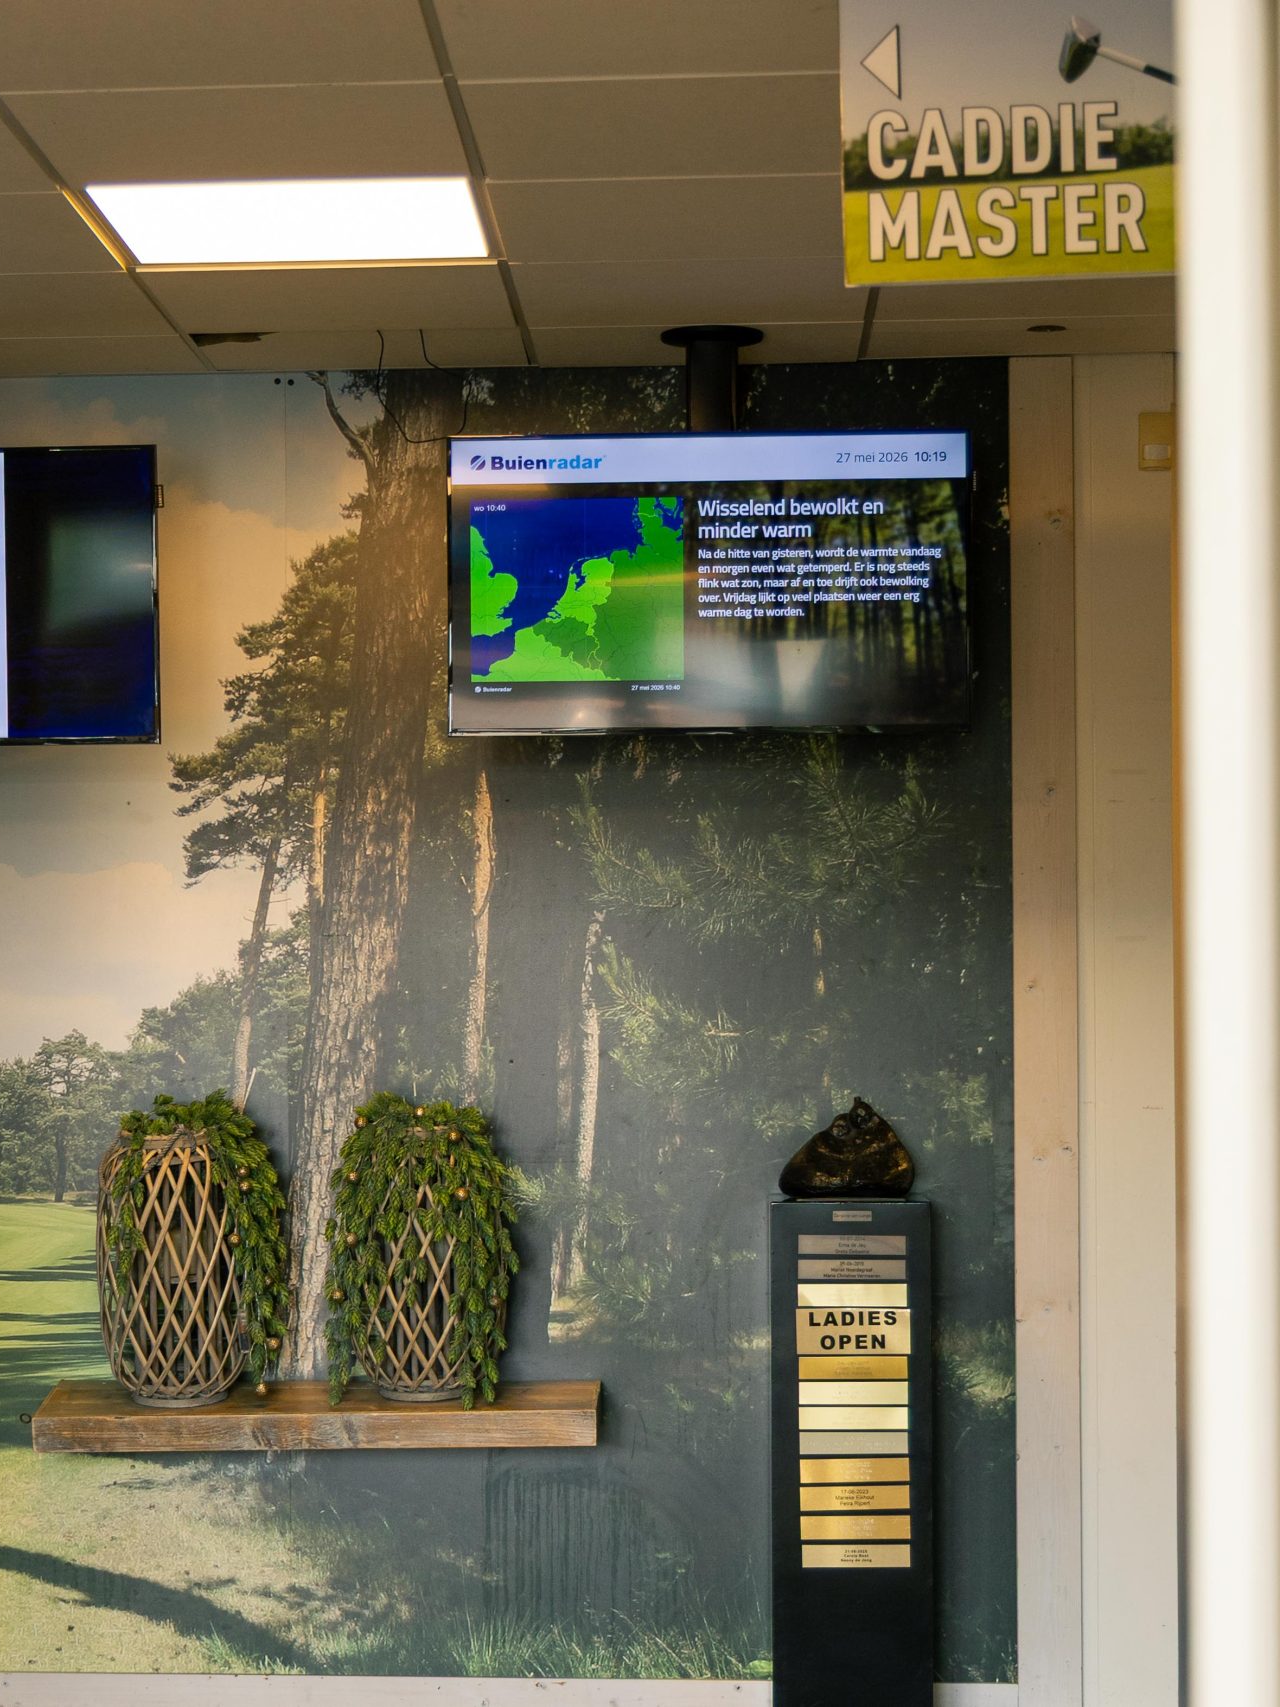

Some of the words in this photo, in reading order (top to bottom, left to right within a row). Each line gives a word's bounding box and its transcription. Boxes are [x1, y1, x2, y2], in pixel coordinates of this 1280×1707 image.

[866, 100, 1119, 181] CADDIE
[867, 181, 1149, 262] MASTER
[490, 455, 603, 471] Buienradar
[836, 452, 851, 463] 27
[854, 452, 875, 463] mei
[878, 451, 908, 463] 2026
[914, 451, 947, 462] 10:19
[486, 504, 507, 512] 10:40
[697, 499, 785, 517] Wisselend
[790, 498, 859, 516] bewolkt
[862, 501, 884, 515] en
[697, 521, 759, 539] minder
[762, 524, 812, 539] warm
[698, 549, 712, 559] Na
[714, 549, 726, 559] de
[727, 548, 751, 559] hitte
[752, 550, 770, 558] van
[772, 548, 814, 560] gisteren,
[816, 548, 845, 558] wordt
[846, 547, 859, 557] de
[860, 547, 899, 557] warmte
[900, 546, 942, 559] vandaag
[698, 565, 711, 573] en
[712, 565, 750, 576] morgen
[751, 565, 775, 573] even
[777, 563, 795, 573] wat
[797, 562, 852, 575] getemperd.
[854, 562, 865, 572] Er
[867, 562, 876, 571] is
[877, 563, 896, 574] nog
[897, 561, 930, 571] steeds
[698, 578, 719, 588] flink
[720, 579, 740, 588] wat
[741, 580, 762, 589] zon,
[763, 579, 789, 588] maar
[790, 577, 802, 587] af
[803, 579, 815, 587] en
[816, 578, 833, 587] toe
[835, 576, 858, 589] drijft
[860, 576, 878, 586] ook
[880, 576, 930, 588] bewolking
[698, 594, 721, 603] over.
[723, 592, 756, 604] Vrijdag
[758, 592, 776, 604] lijkt
[777, 593, 790, 603] op
[792, 592, 812, 602] veel
[813, 591, 855, 603] plaatsen
[857, 592, 882, 600] weer
[883, 592, 901, 600] een
[903, 592, 920, 602] erg
[698, 608, 732, 617] warme
[733, 607, 752, 619] dag
[753, 608, 764, 617] te
[765, 607, 805, 617] worden.
[808, 1310, 898, 1327] LADIES
[820, 1334, 886, 1350] OPEN
